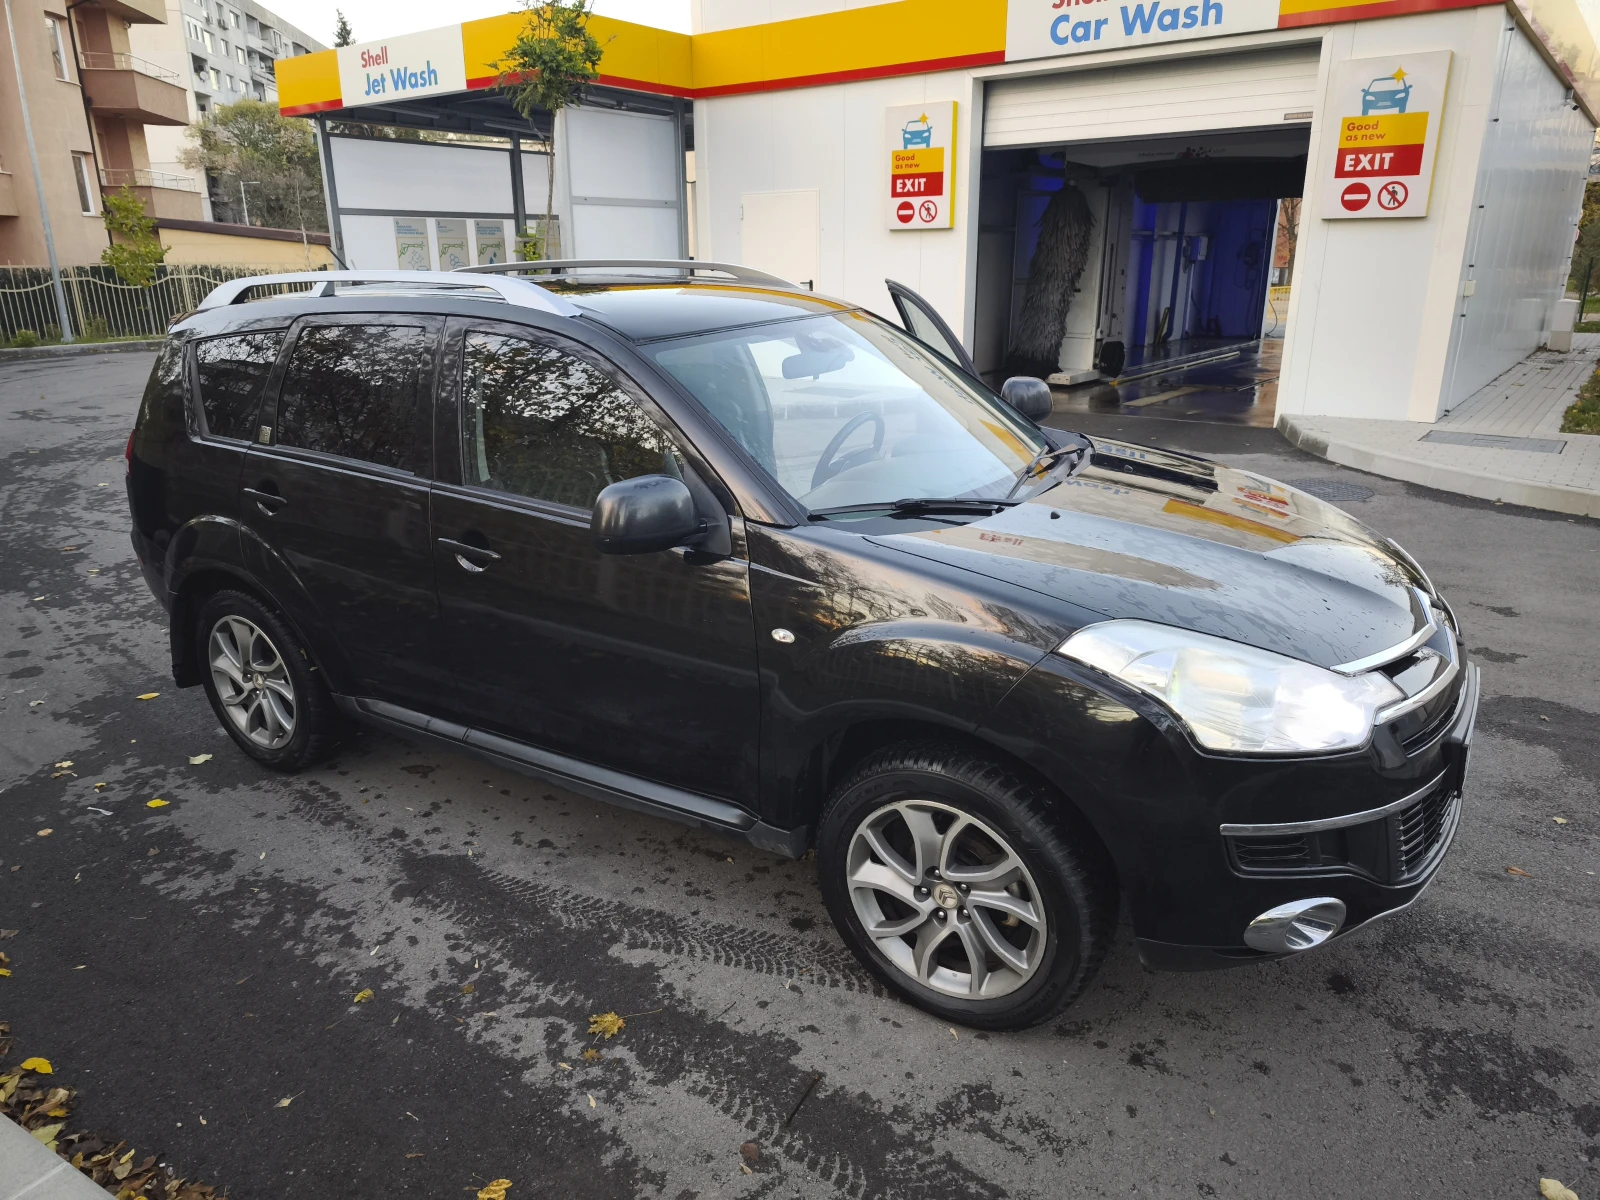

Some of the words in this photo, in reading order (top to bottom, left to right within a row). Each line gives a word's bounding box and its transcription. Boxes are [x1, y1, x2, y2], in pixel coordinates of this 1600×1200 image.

[1050, 14, 1108, 46] Car
[1120, 0, 1224, 36] Wash
[361, 45, 389, 69] Shell
[365, 73, 387, 96] Jet
[389, 60, 439, 91] Wash
[1347, 120, 1379, 132] Good
[1345, 134, 1358, 142] as
[1361, 133, 1386, 141] new
[895, 153, 915, 162] Good
[1343, 152, 1394, 172] EXIT
[896, 177, 926, 193] EXIT
